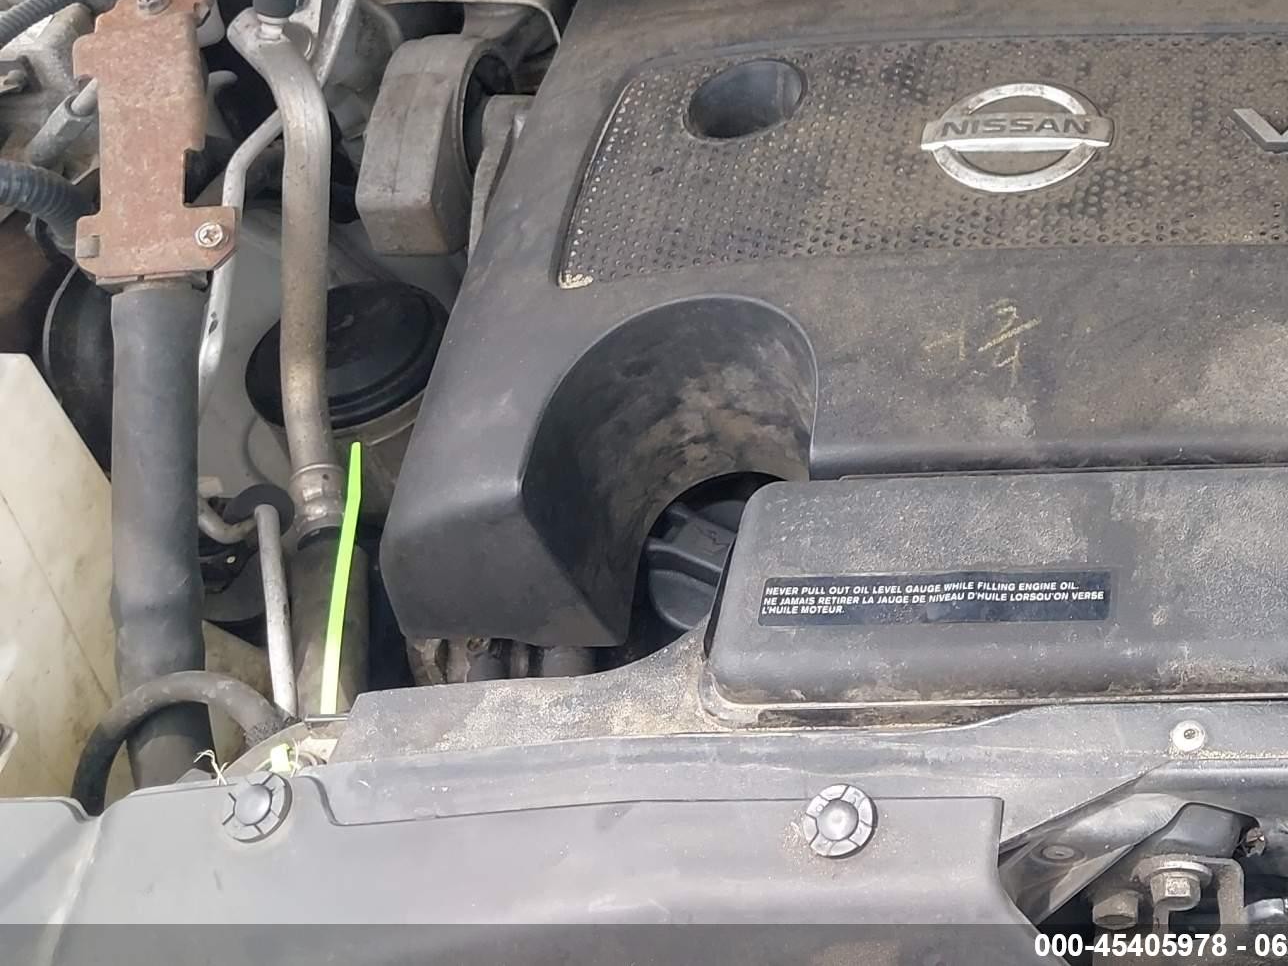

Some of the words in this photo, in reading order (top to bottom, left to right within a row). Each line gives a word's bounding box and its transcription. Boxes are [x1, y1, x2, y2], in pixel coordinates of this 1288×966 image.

[941, 118, 1090, 137] NISSAN
[765, 586, 799, 595] NEVER
[801, 586, 826, 595] PULL
[828, 586, 850, 595] OUT
[853, 586, 870, 594] OIL
[872, 585, 902, 594] LEVEL
[905, 584, 941, 594] GAUGE
[943, 581, 974, 591] WHILE
[977, 581, 1016, 591] FILLING
[1018, 581, 1057, 591] ENGINE
[1060, 581, 1080, 590] OIL.
[763, 597, 778, 606] NE
[779, 597, 815, 606] JAMAIS
[818, 596, 860, 605] RETIRER
[862, 596, 875, 605] LA
[877, 595, 909, 604] JAUGE
[911, 594, 927, 604] DE
[928, 592, 965, 603] NIVEAU
[967, 591, 1008, 601] D'HUILE
[1071, 591, 1105, 600] VERSE
[761, 605, 799, 615] L'HUILE
[800, 605, 846, 614] MOTEUR.
